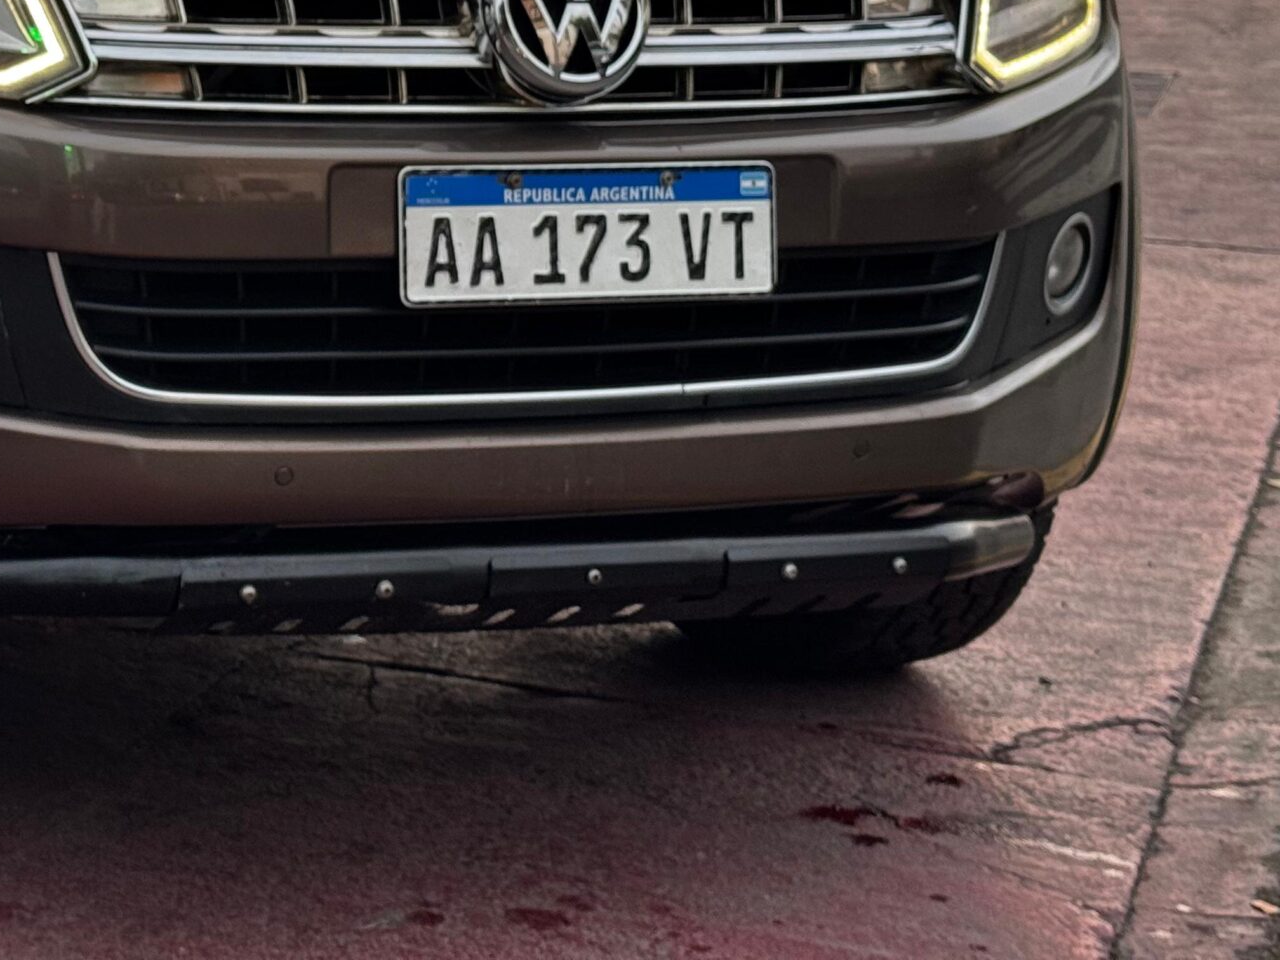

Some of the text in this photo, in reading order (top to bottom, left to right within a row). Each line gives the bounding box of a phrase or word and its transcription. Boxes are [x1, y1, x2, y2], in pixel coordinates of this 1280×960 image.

[503, 185, 676, 203] REPUBLICA ARGENTINA
[424, 211, 754, 288] AA 173 VT
